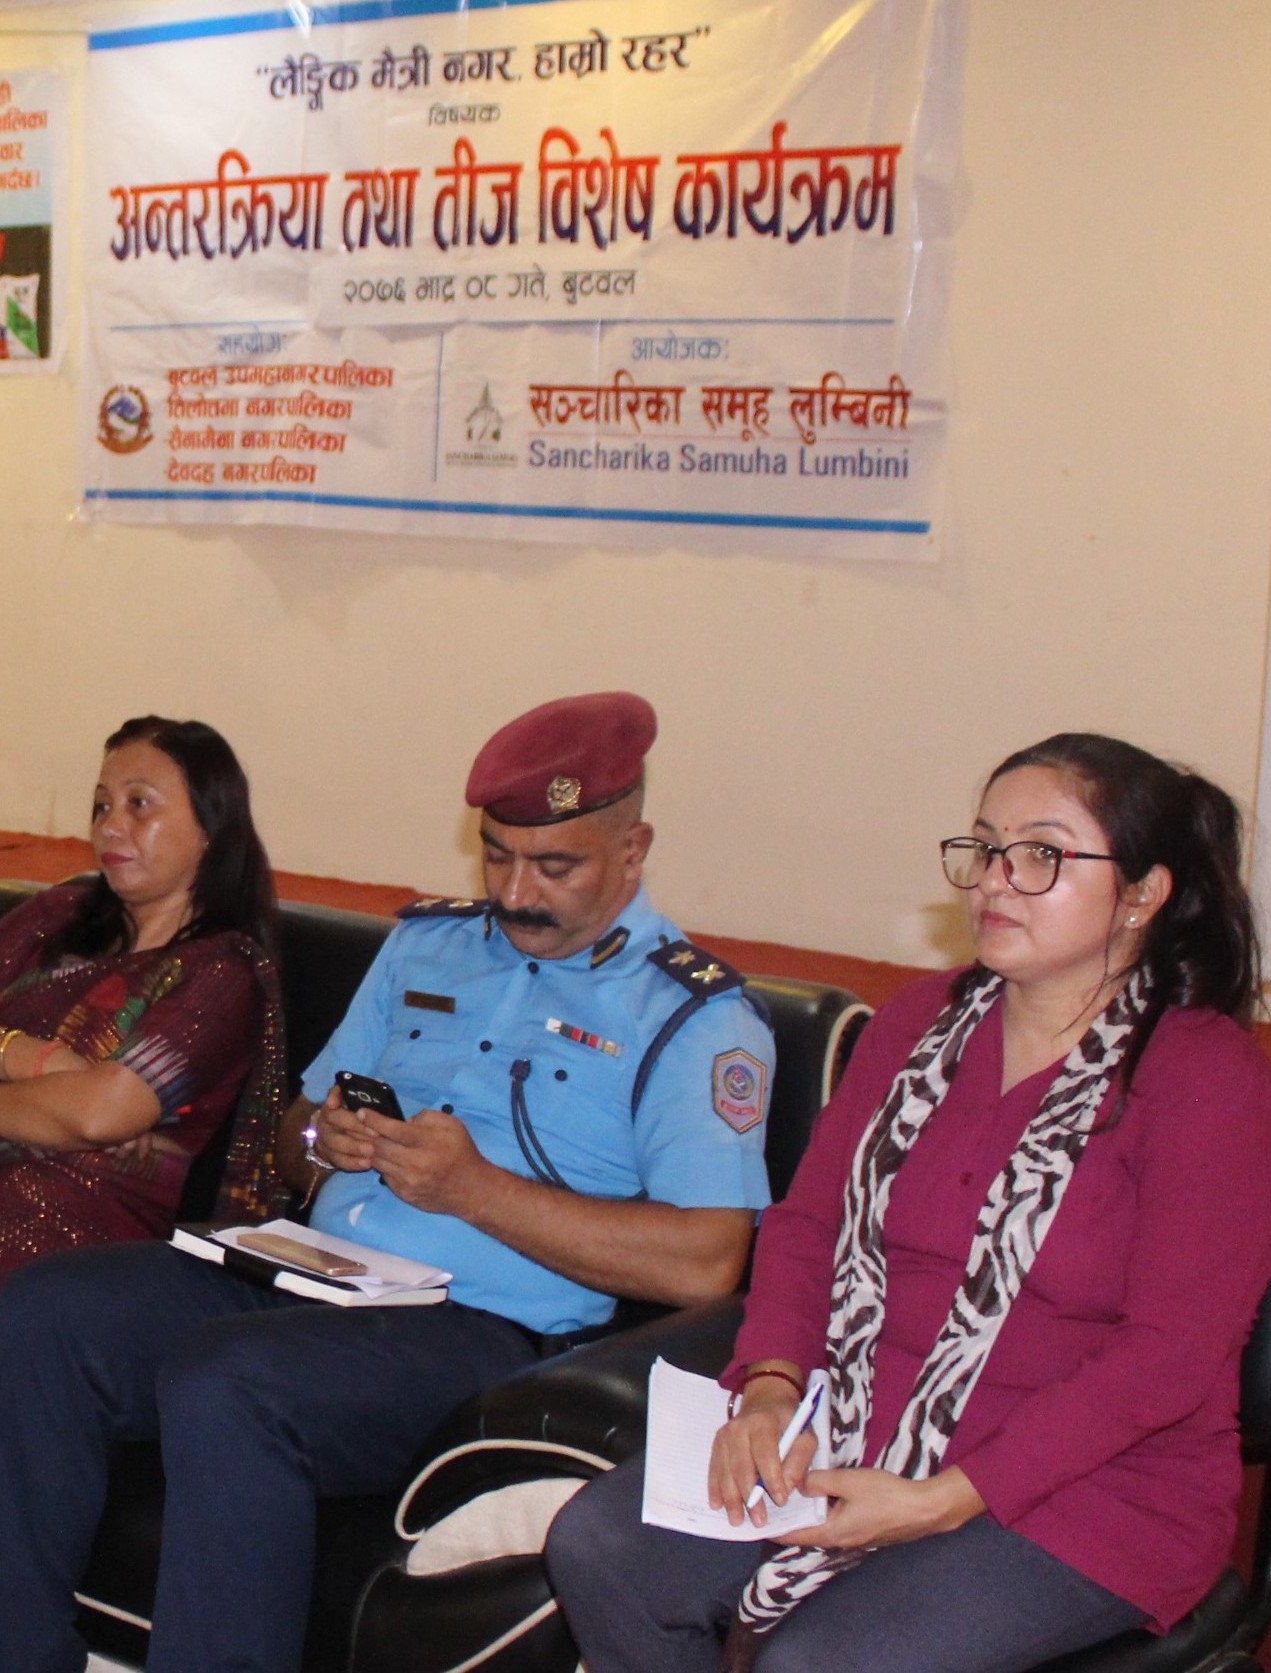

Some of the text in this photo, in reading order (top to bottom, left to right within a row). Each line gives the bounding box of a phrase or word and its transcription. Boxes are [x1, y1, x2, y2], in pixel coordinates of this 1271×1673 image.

[371, 44, 430, 91] मैत्री
[534, 28, 611, 79] हाम्रो
[428, 102, 501, 128] विषयक
[110, 120, 903, 262] अन्तरक्रिया तथा तीज विशेष कार्यक्रम
[343, 277, 406, 304] २०७६
[465, 274, 498, 299] ०८
[562, 269, 637, 304] बुटवल
[528, 368, 911, 445] सञ्चारिका समूह लुम्बिनी
[529, 439, 671, 473] Sancharika
[680, 443, 788, 476] Samuha
[799, 448, 910, 480] Lumbini
